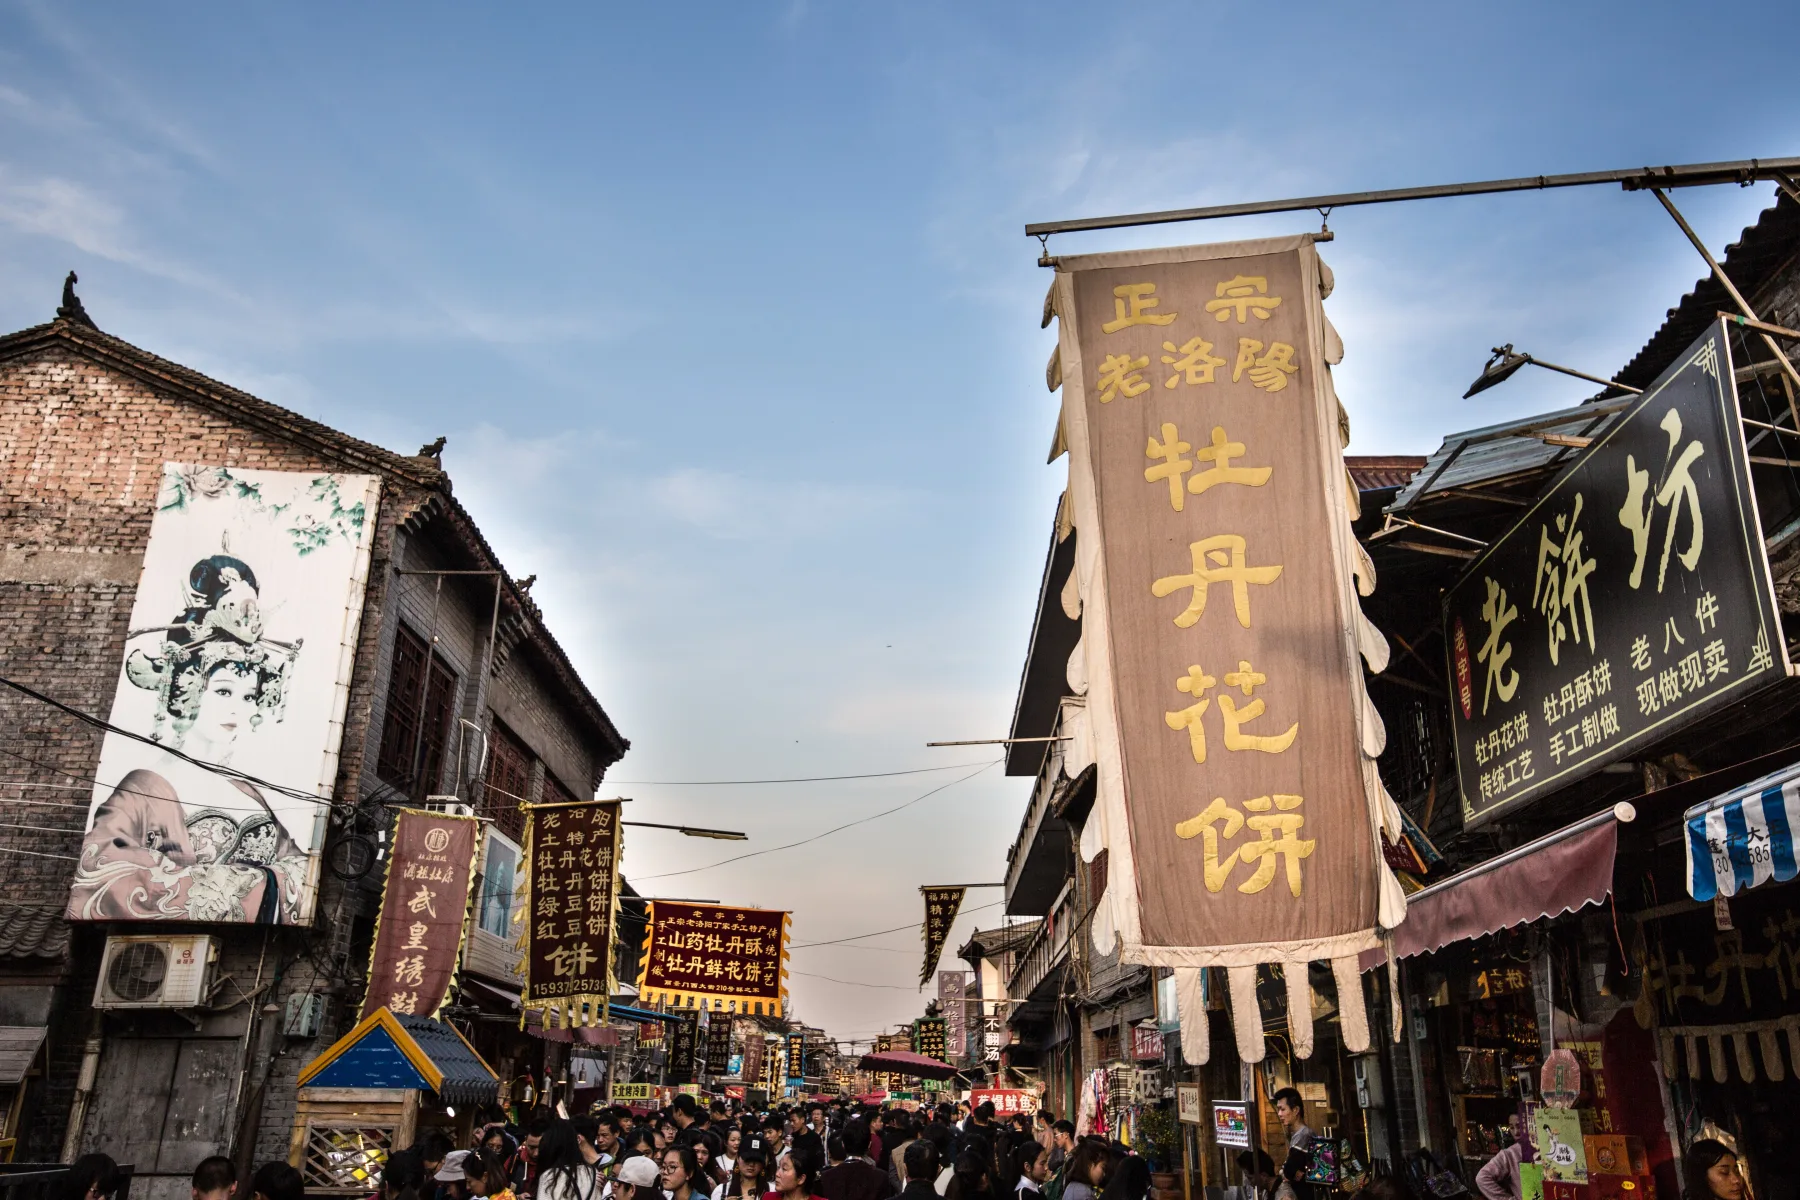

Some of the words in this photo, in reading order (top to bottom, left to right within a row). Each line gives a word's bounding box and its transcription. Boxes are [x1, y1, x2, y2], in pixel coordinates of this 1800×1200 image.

[1102, 275, 1282, 334] 正宗
[1144, 423, 1316, 897] 牡丹花饼
[1455, 627, 1471, 711] 老字号
[1475, 711, 1530, 767] 牡丹花饼
[1543, 658, 1612, 727] 牡丹酥饼
[1630, 591, 1719, 672] 老八件
[1479, 750, 1535, 802] 传统工艺
[1549, 703, 1620, 765] 手工制做
[1635, 639, 1729, 716] 现做现卖
[540, 829, 611, 848] 土特产
[538, 847, 612, 871] 牡丹花饼
[537, 869, 611, 893] 牡丹饼
[536, 891, 609, 917] 绿豆饼
[693, 910, 746, 921] 老字号
[536, 914, 608, 940] 红豆饼
[668, 931, 763, 957] 山药牡丹酥
[544, 942, 598, 976] 饼
[666, 952, 762, 983] 牡丹鲜花饼
[984, 1018, 1000, 1061] 不翻汤
[612, 1085, 648, 1097] 东北烤冷面
